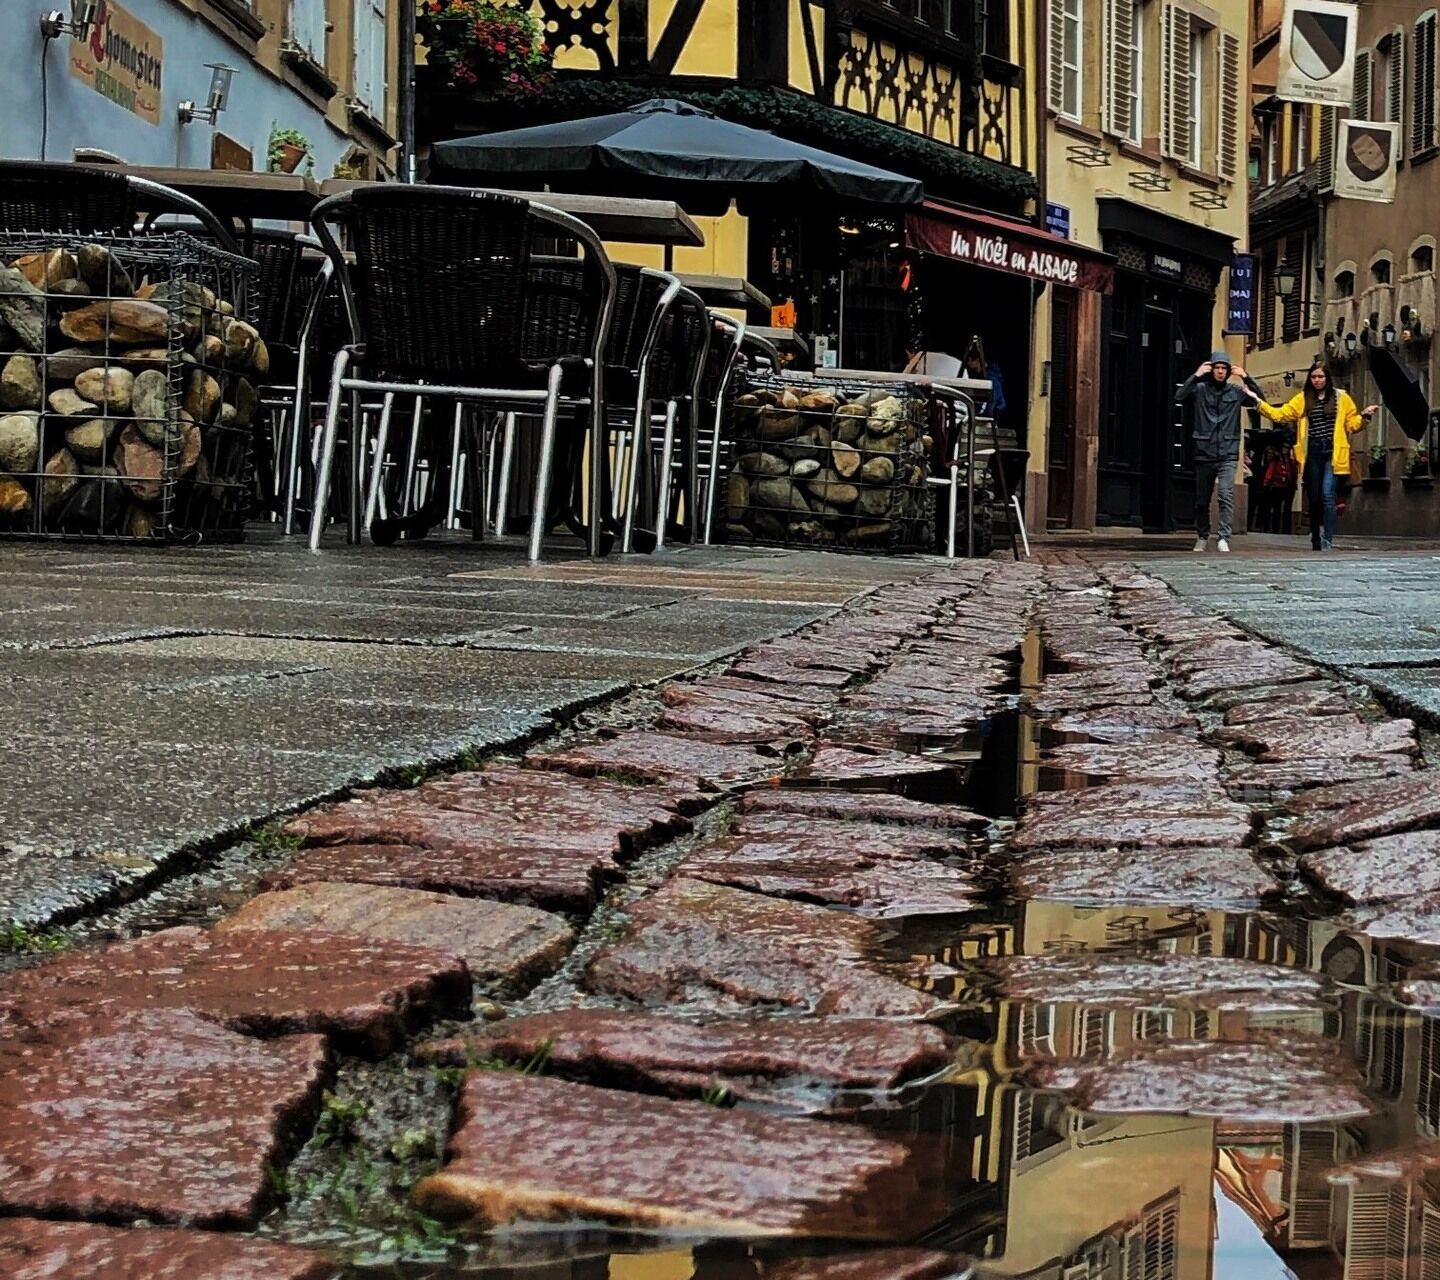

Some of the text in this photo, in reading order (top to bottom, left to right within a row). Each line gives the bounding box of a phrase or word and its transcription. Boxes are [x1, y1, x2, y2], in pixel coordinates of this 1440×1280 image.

[951, 230, 970, 258] Un
[1011, 252, 1026, 271] en
[1028, 251, 1078, 282] ALSACE
